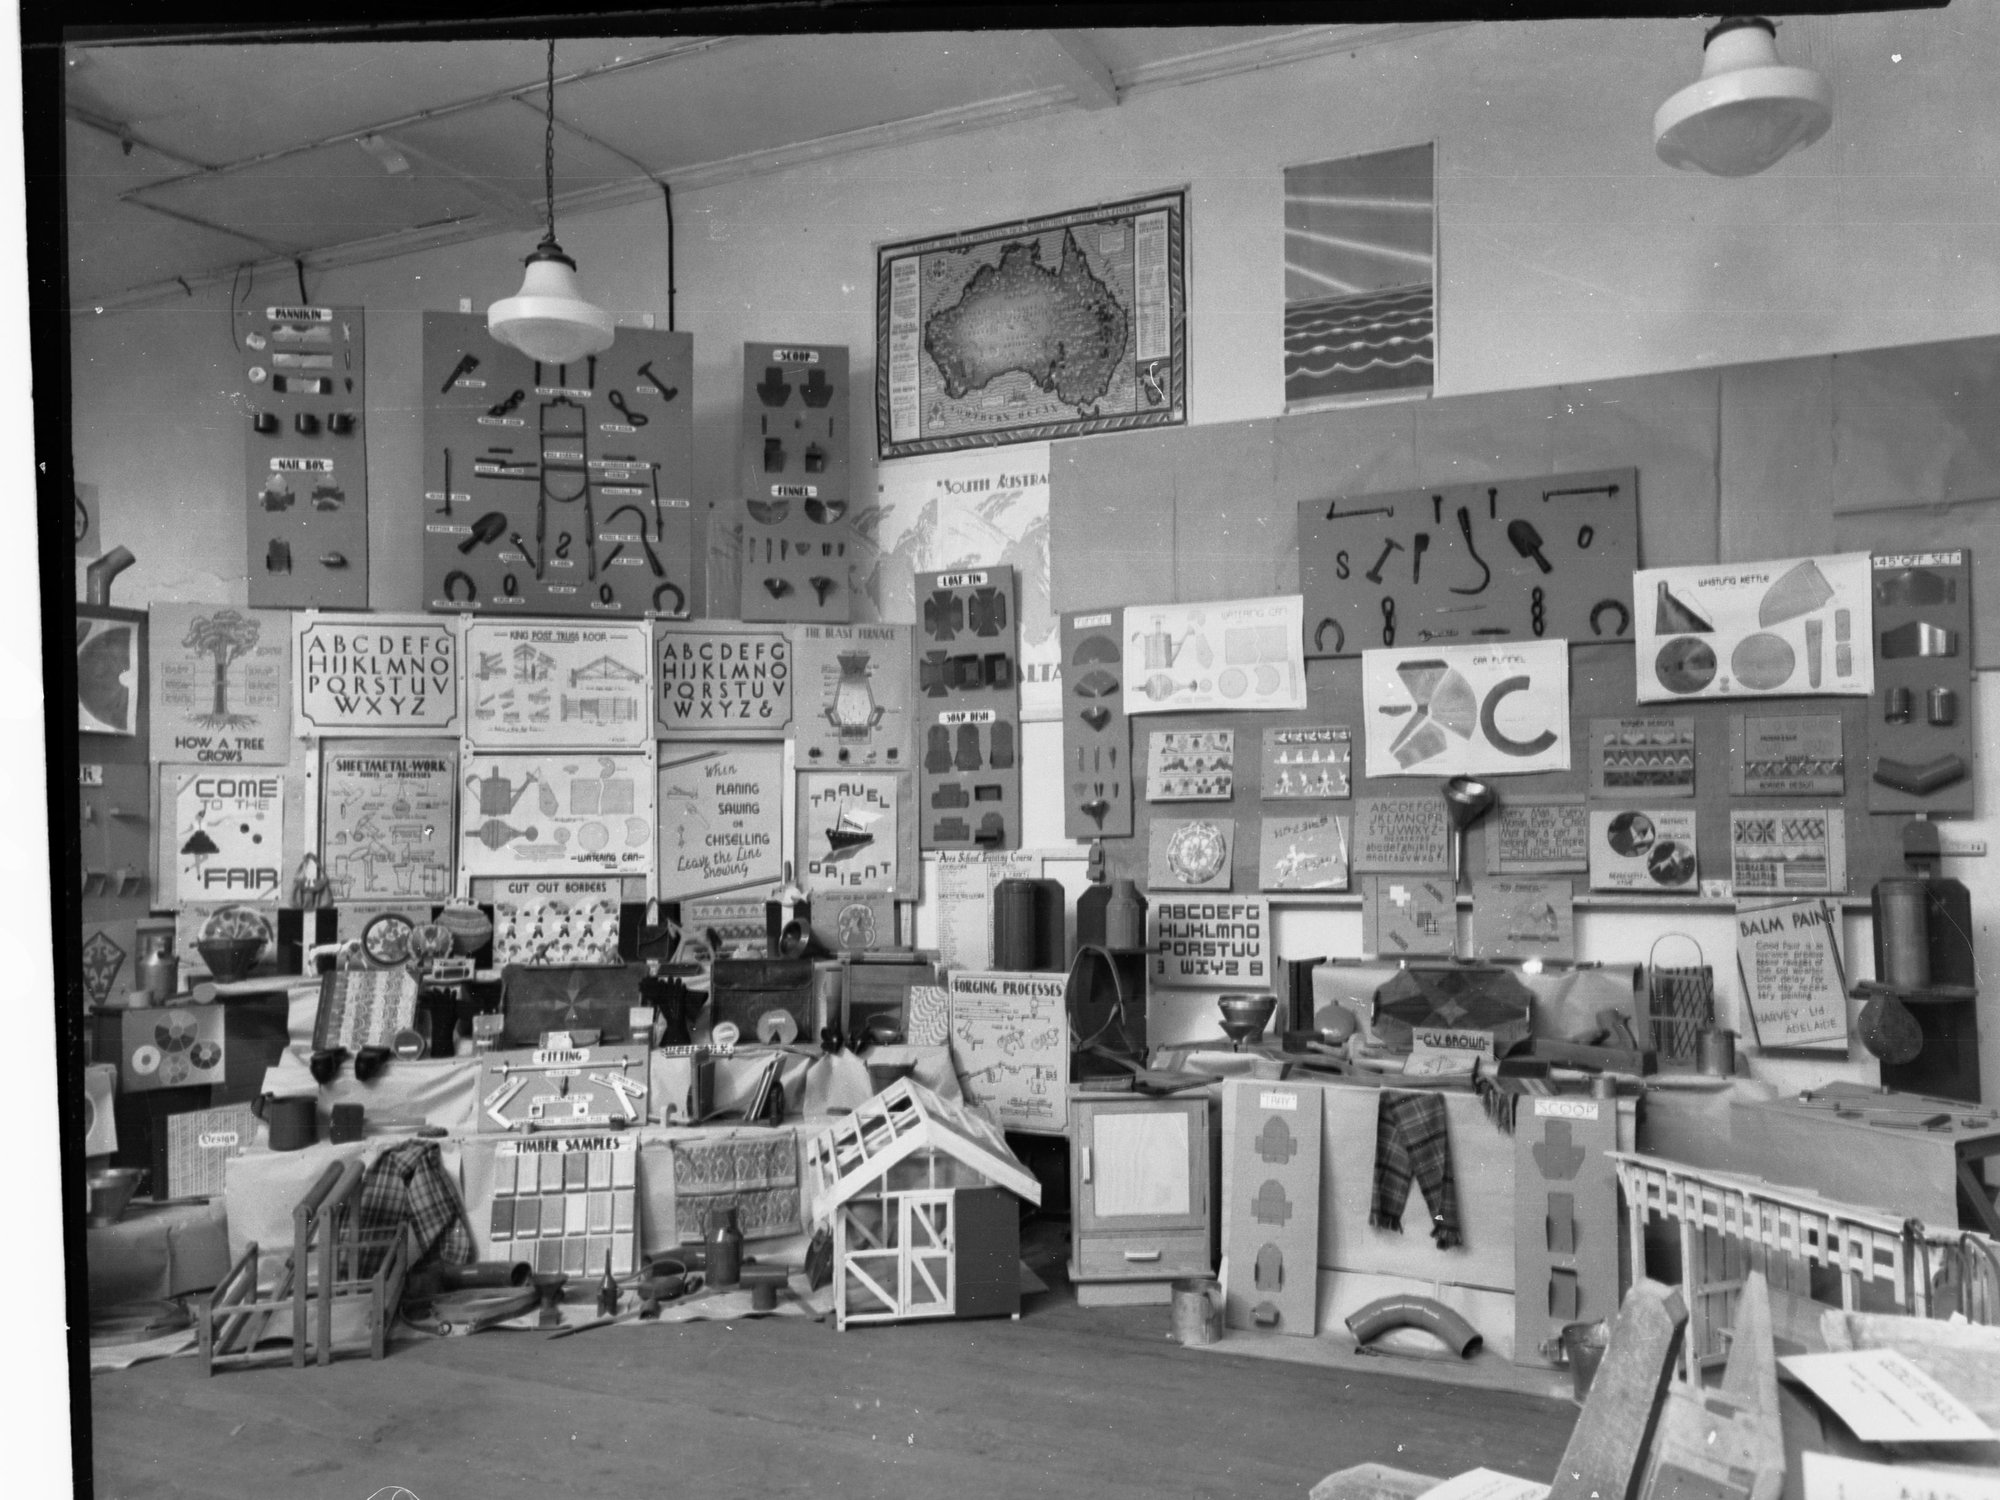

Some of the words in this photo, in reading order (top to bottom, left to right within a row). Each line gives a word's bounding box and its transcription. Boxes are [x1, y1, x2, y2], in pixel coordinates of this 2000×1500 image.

[275, 308, 322, 320] PANNIKIN
[780, 351, 811, 362] SCOOP
[278, 459, 300, 471] NAIL
[305, 460, 325, 471] BOX
[943, 575, 963, 587] LOAF
[968, 573, 982, 585] TIN
[510, 630, 529, 641] KING
[531, 630, 552, 641] POST
[805, 627, 822, 638] THE
[825, 627, 853, 639] BLAST
[858, 628, 895, 640] FURNACE
[946, 711, 966, 723] SOAP
[970, 711, 989, 722] DISH
[175, 736, 212, 750] HOW
[218, 737, 230, 750] A
[234, 737, 265, 750] TREE
[197, 749, 243, 763] GROWS
[704, 761, 738, 779] When
[195, 779, 278, 798] COME
[715, 782, 760, 796] PLANING
[810, 783, 891, 808] TRAVEL
[198, 798, 224, 810] TO
[234, 798, 270, 810] THE
[718, 802, 760, 815] SAWING
[705, 833, 770, 847] CHISELLING
[204, 868, 278, 890] FAIR
[808, 861, 891, 886] ORIENT
[508, 882, 530, 894] CUT
[536, 882, 560, 894] OUT
[565, 882, 607, 894] BORDERS
[1740, 916, 1784, 938] BALM
[1792, 906, 1836, 929] PAINT
[954, 980, 998, 995] FORGING
[1003, 981, 1063, 998] PROCESSES
[541, 1051, 582, 1062] FITTING
[201, 1133, 236, 1145] Design
[514, 1139, 559, 1153] TIMBER
[565, 1136, 620, 1150] SAMPLES
